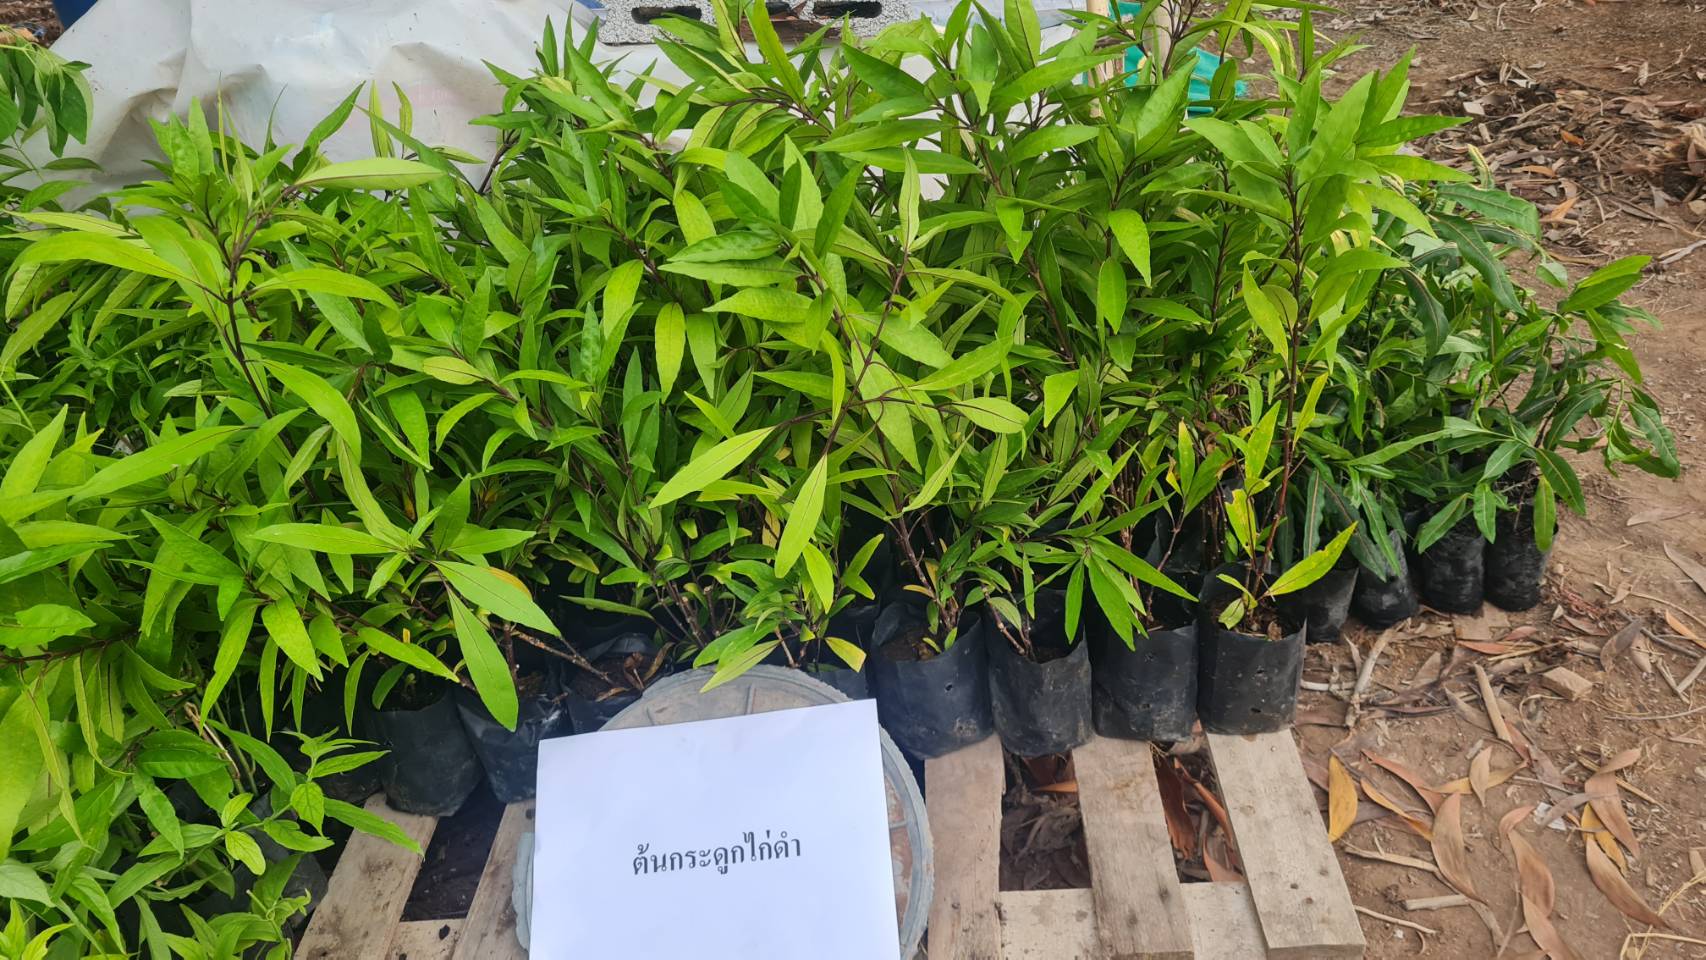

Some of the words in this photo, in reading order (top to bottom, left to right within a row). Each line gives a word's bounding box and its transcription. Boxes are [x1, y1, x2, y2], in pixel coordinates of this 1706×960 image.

[632, 829, 801, 875] ต้นกระดูกไก่ดำ
